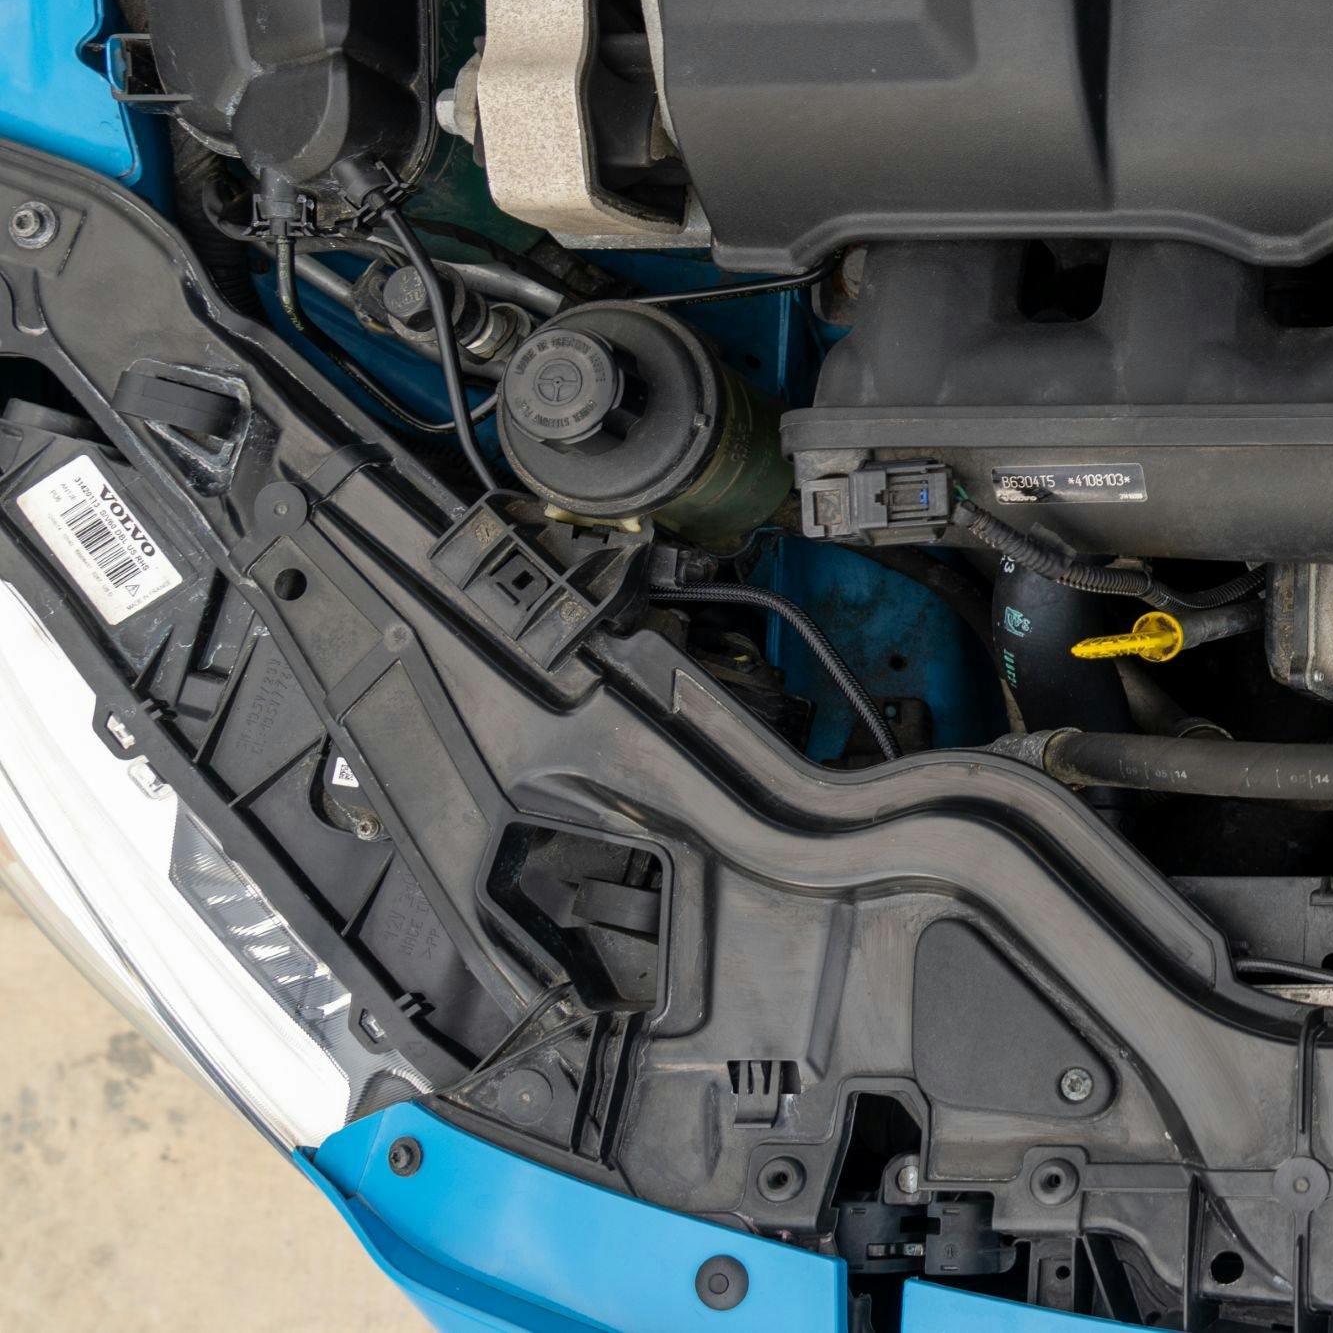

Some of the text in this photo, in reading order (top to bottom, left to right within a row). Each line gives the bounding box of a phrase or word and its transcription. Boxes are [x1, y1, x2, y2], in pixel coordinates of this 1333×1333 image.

[1002, 475, 1056, 489] B6304T5
[100, 484, 156, 557] VOLVO
[127, 545, 138, 557] US
[1174, 769, 1188, 780] 14
[1314, 773, 1331, 784] 14
